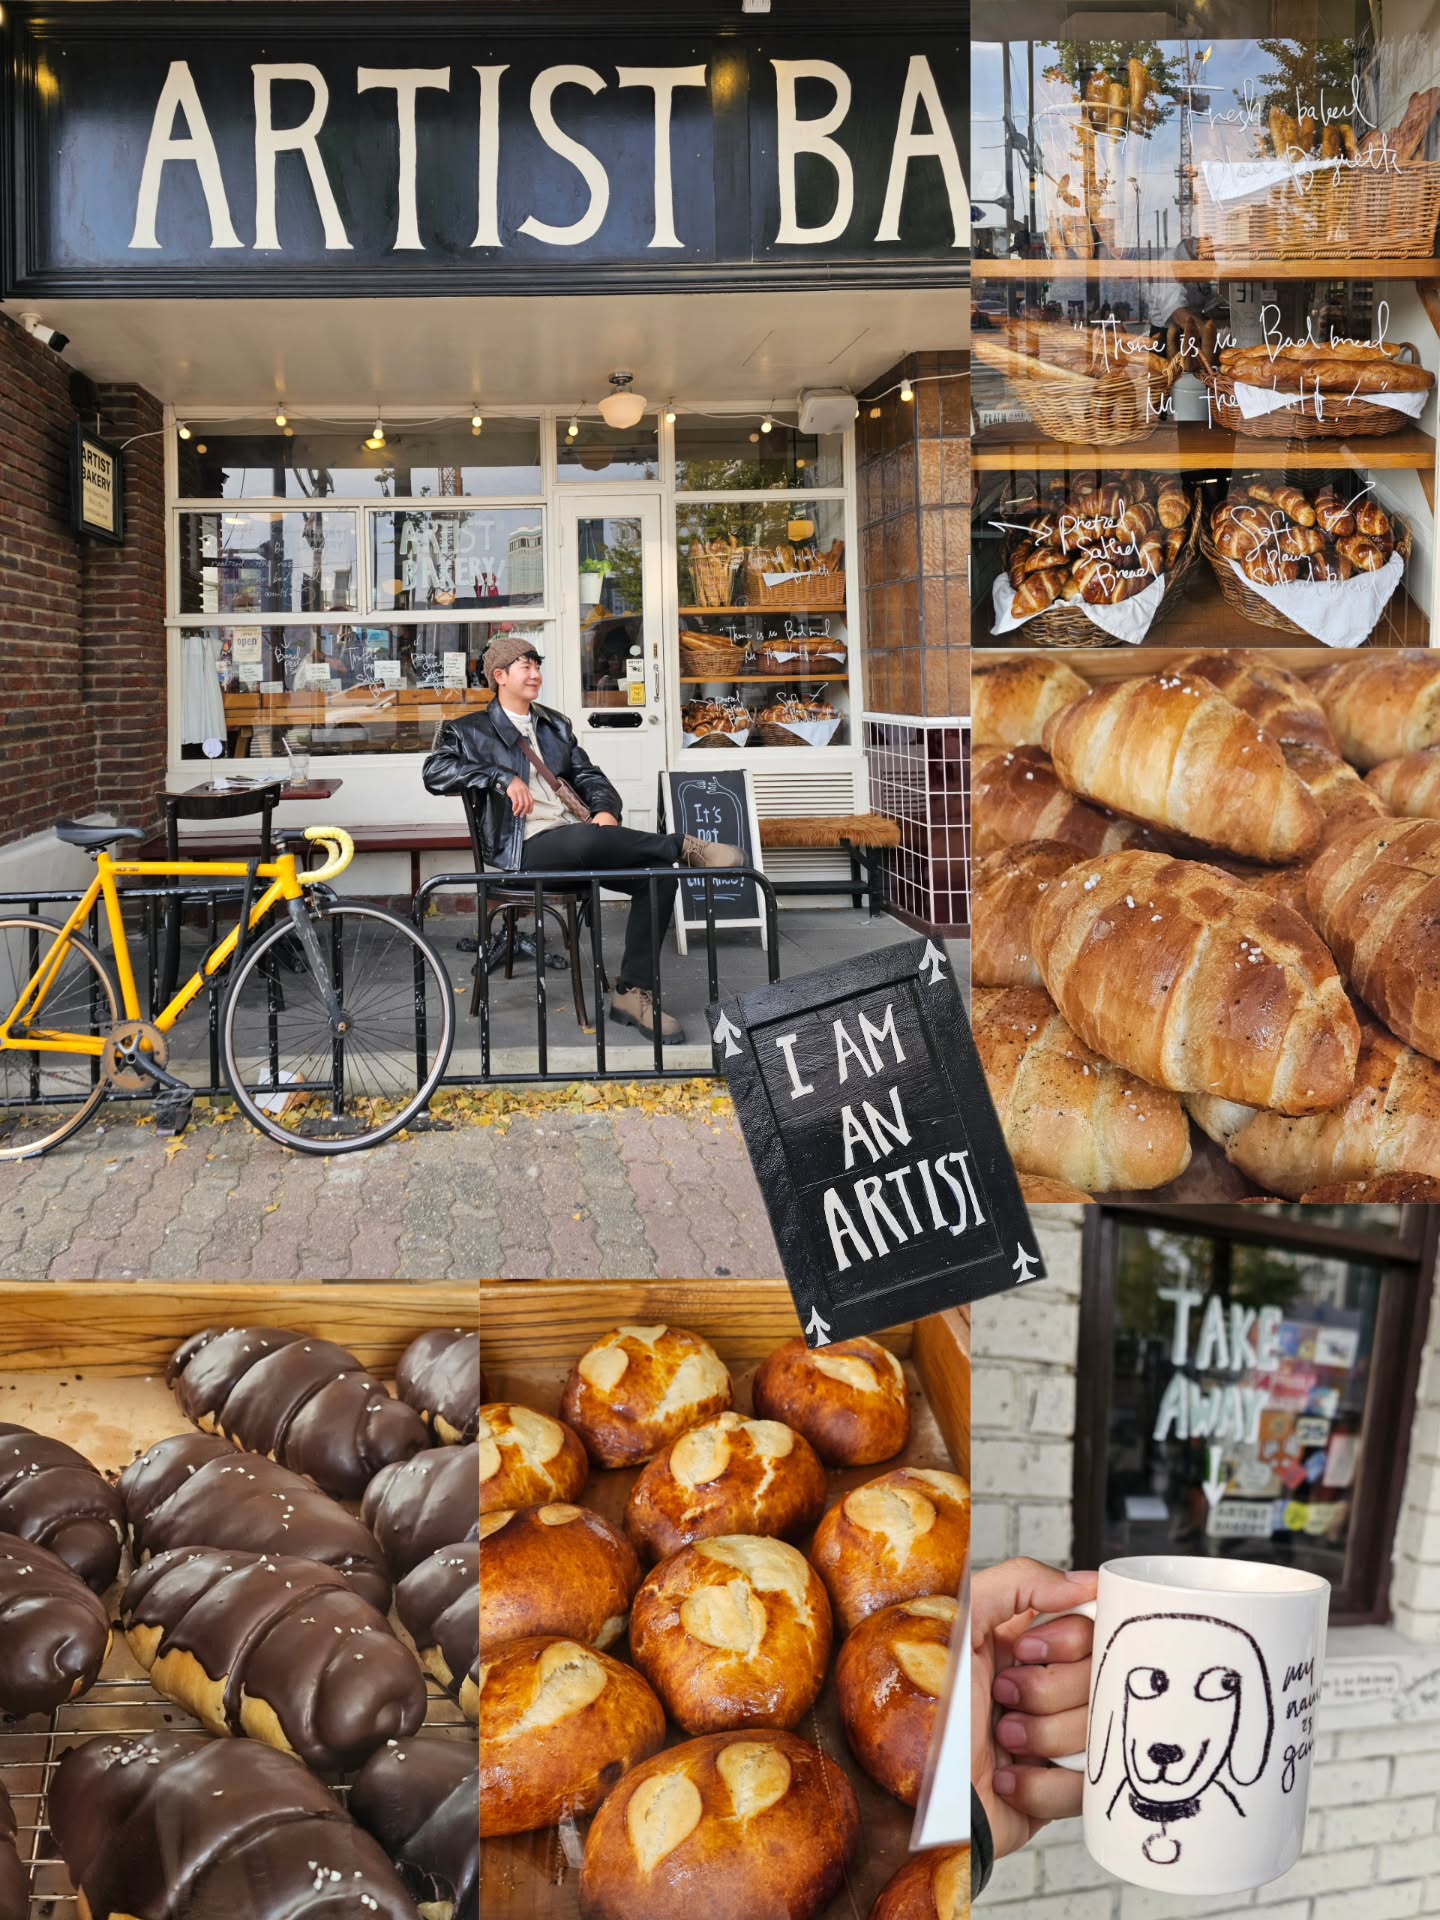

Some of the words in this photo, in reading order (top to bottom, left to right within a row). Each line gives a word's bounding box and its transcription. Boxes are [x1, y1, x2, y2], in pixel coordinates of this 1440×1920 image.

[127, 60, 709, 251] ARTIST
[769, 54, 970, 248] BA
[1178, 333, 1200, 358] is
[81, 447, 111, 475] ARTIST
[81, 465, 111, 493] BAKERY
[400, 519, 495, 555] ARTIST
[237, 637, 257, 648] open
[693, 803, 722, 824] It's
[775, 1033, 814, 1100] I
[832, 1003, 907, 1084] AM
[844, 1086, 913, 1170] AN
[823, 1150, 986, 1272] ARTIST
[1157, 1288, 1283, 1372] TAKE
[1152, 1373, 1271, 1444] AWAY
